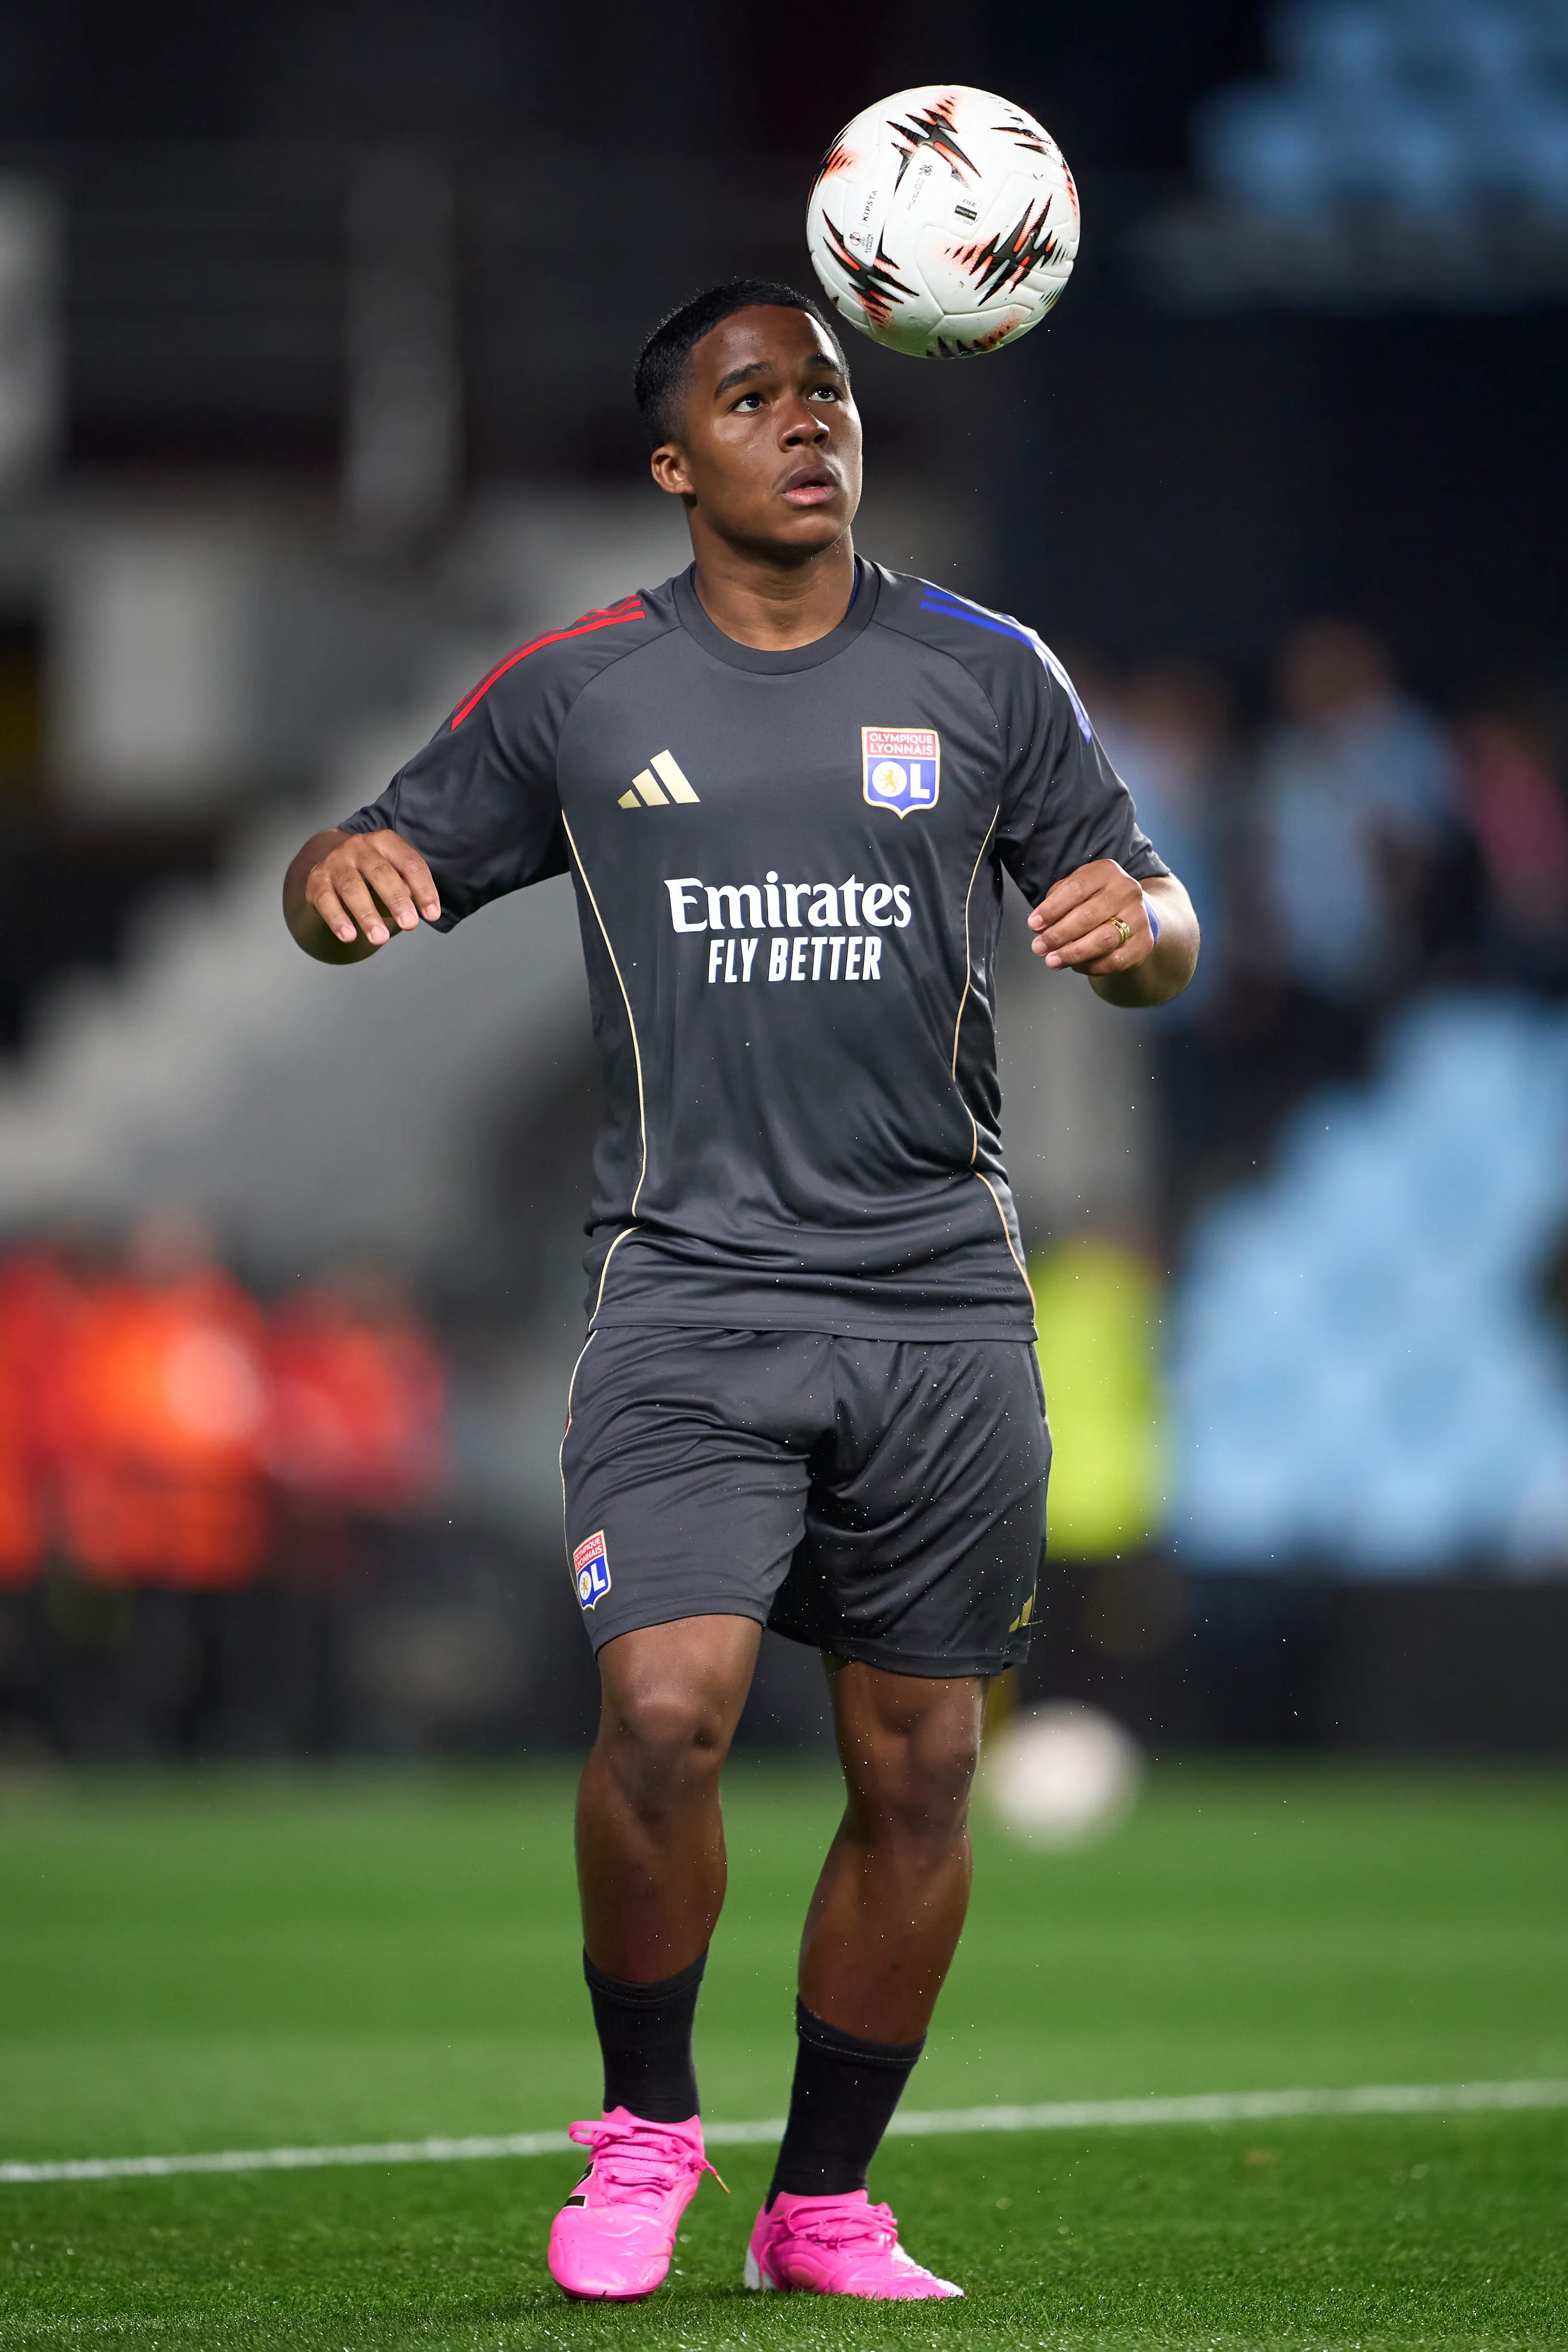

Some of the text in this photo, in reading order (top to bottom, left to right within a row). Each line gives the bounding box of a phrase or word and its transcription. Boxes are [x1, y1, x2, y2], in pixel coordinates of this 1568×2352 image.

[862, 190, 878, 222] KIPSTA
[869, 733, 933, 744] OLYMPIQUE
[870, 743, 933, 756] LYONNAIS
[871, 761, 930, 799] OL
[663, 870, 912, 933] Emirates
[708, 936, 882, 984] FLY BETTER
[575, 1537, 601, 1562] OLYMPIQUE
[575, 1545, 602, 1571] LYONNAIS
[579, 1563, 606, 1600] OL
